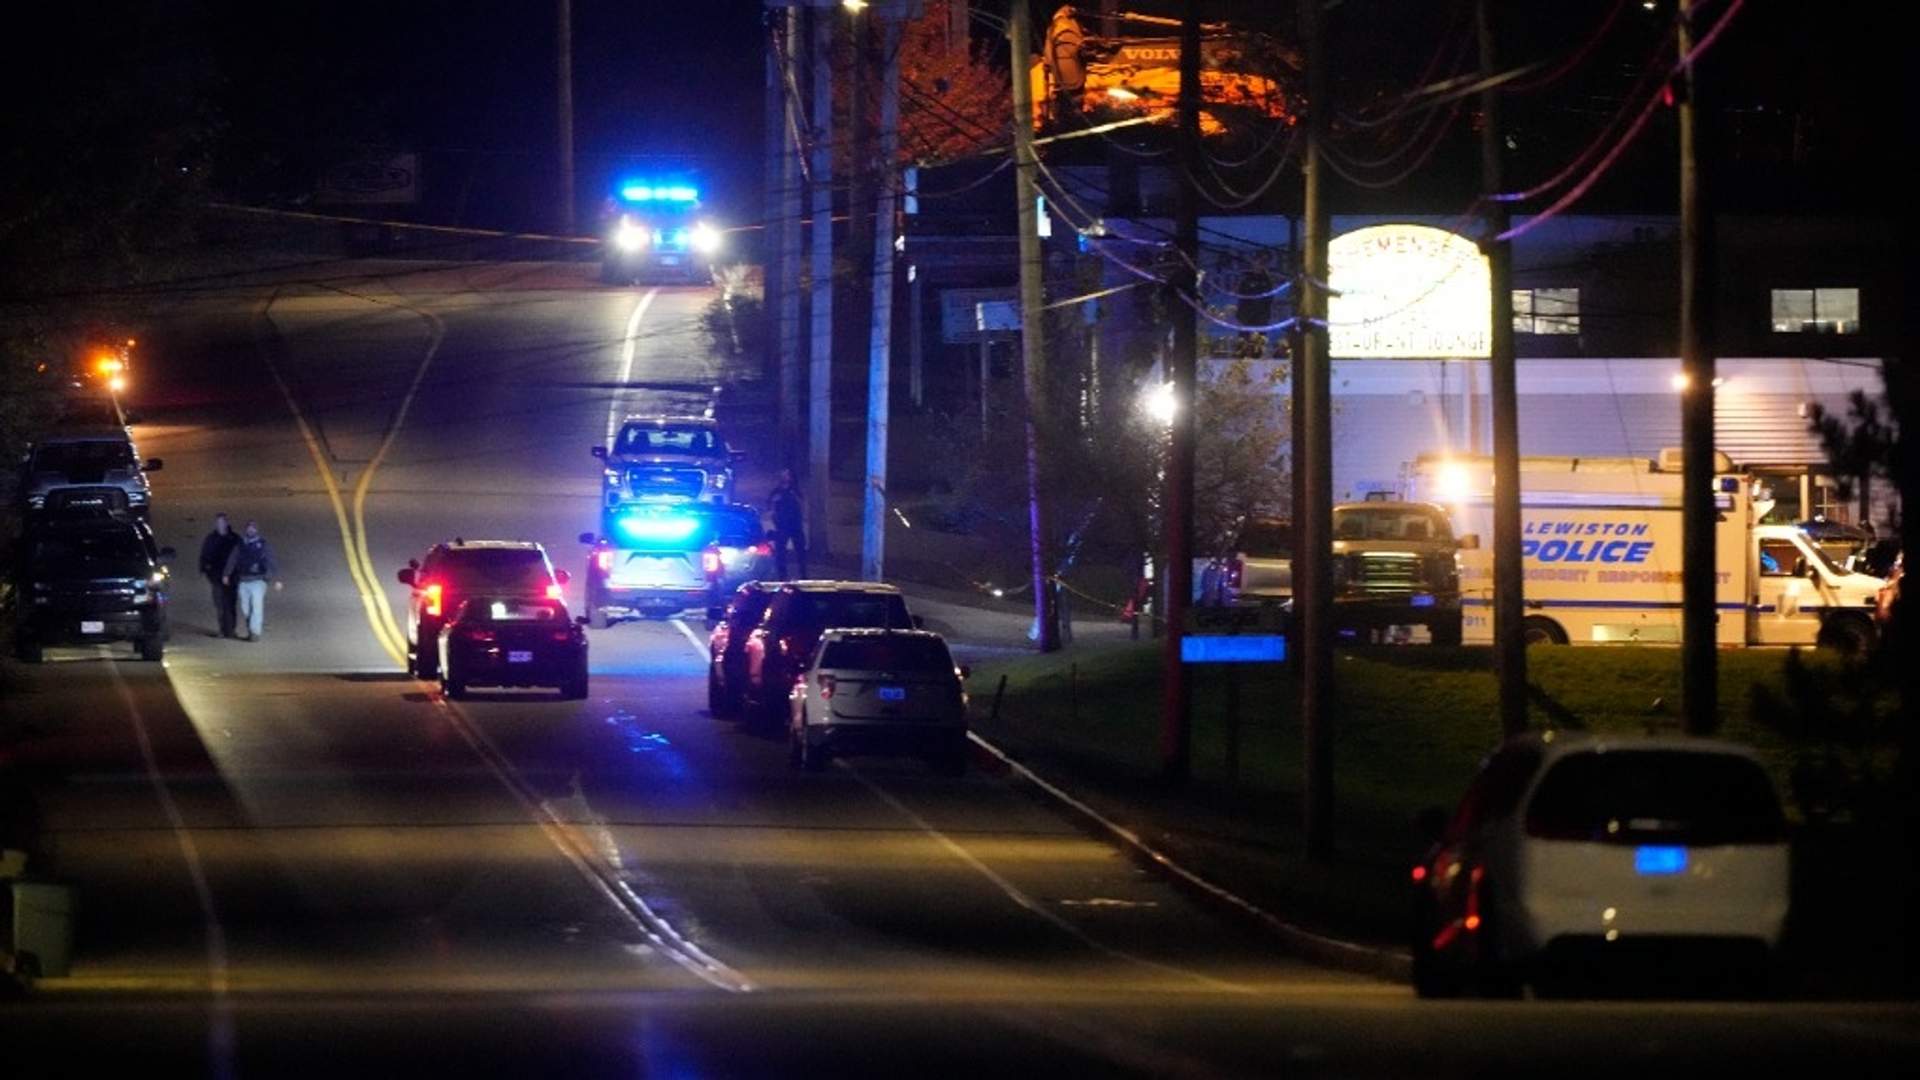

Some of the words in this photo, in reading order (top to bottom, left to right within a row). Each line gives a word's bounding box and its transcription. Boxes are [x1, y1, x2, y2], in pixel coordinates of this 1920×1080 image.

[1122, 48, 1181, 60] VOLV
[1524, 522, 1648, 536] LEWISTON
[1521, 540, 1654, 562] POLICE
